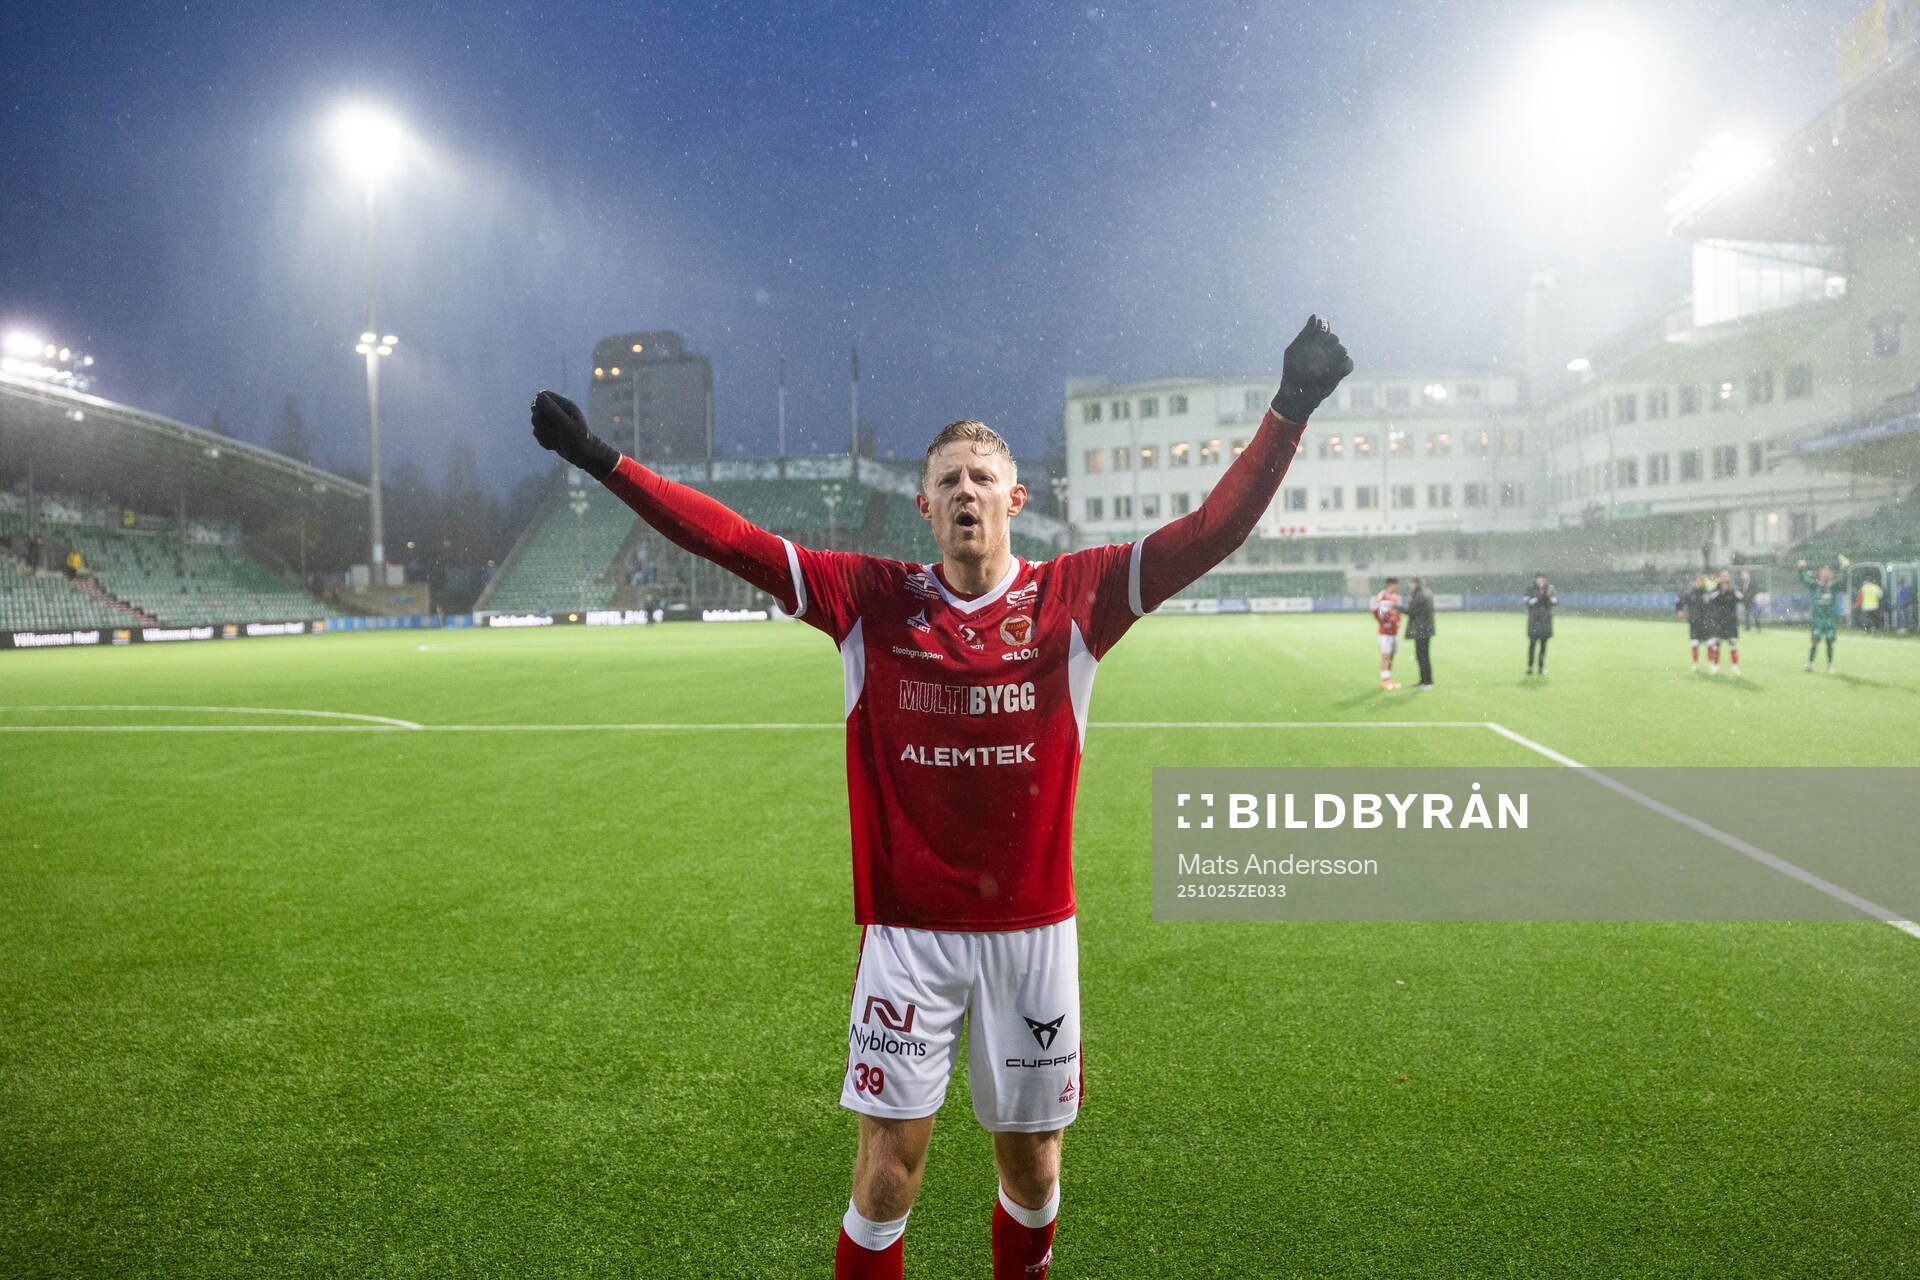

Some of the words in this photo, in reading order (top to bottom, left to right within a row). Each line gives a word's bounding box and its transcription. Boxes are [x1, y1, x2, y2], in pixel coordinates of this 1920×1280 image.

[906, 619, 931, 633] SELECT
[899, 680, 1036, 715] MULTIBYGG
[900, 743, 1036, 767] ALEMTEK
[849, 1023, 926, 1057] Nybloms
[855, 1062, 884, 1096] 39
